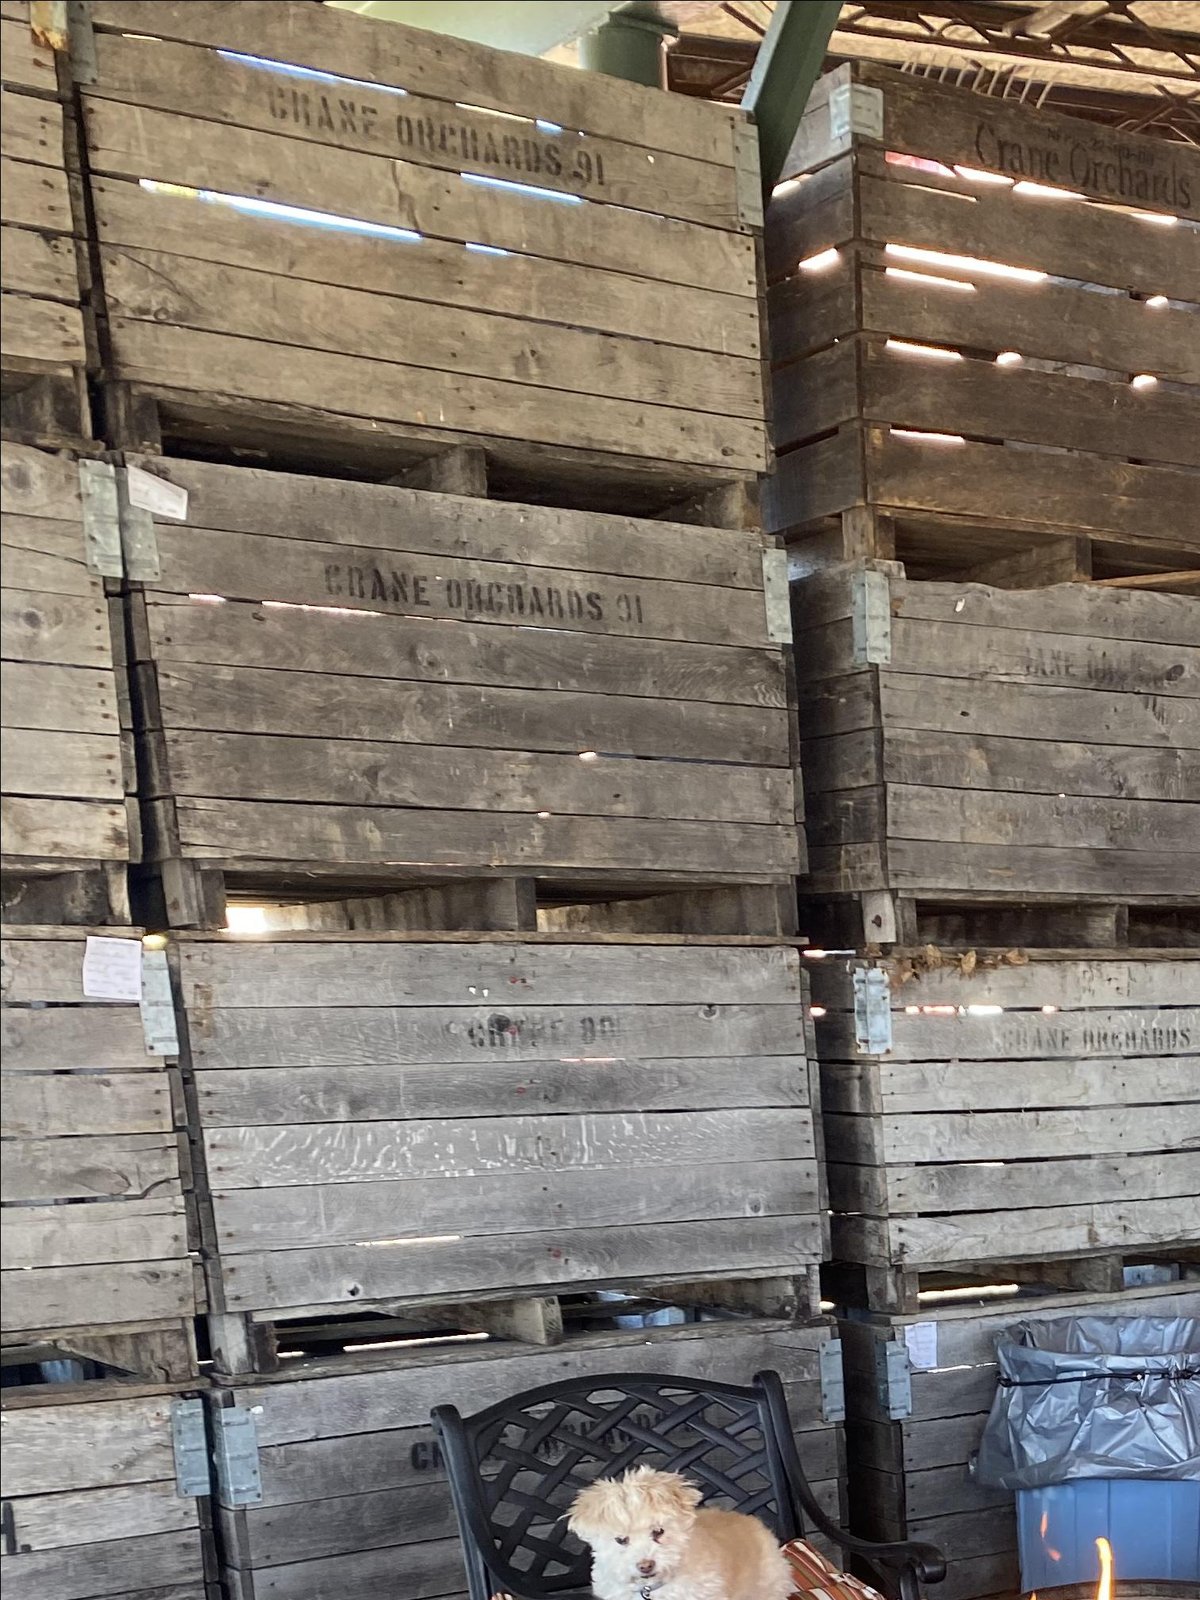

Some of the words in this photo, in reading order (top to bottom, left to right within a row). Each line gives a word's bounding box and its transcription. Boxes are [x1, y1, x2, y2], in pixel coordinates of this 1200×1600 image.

[268, 87, 378, 137] CRANE
[396, 114, 562, 177] ORCHARDS
[975, 122, 1060, 181] Crane
[1070, 141, 1191, 209] Orchards
[324, 563, 431, 607] CRANE
[446, 578, 604, 622] ORCHARDS
[1083, 1027, 1192, 1051] ORCHARDS
